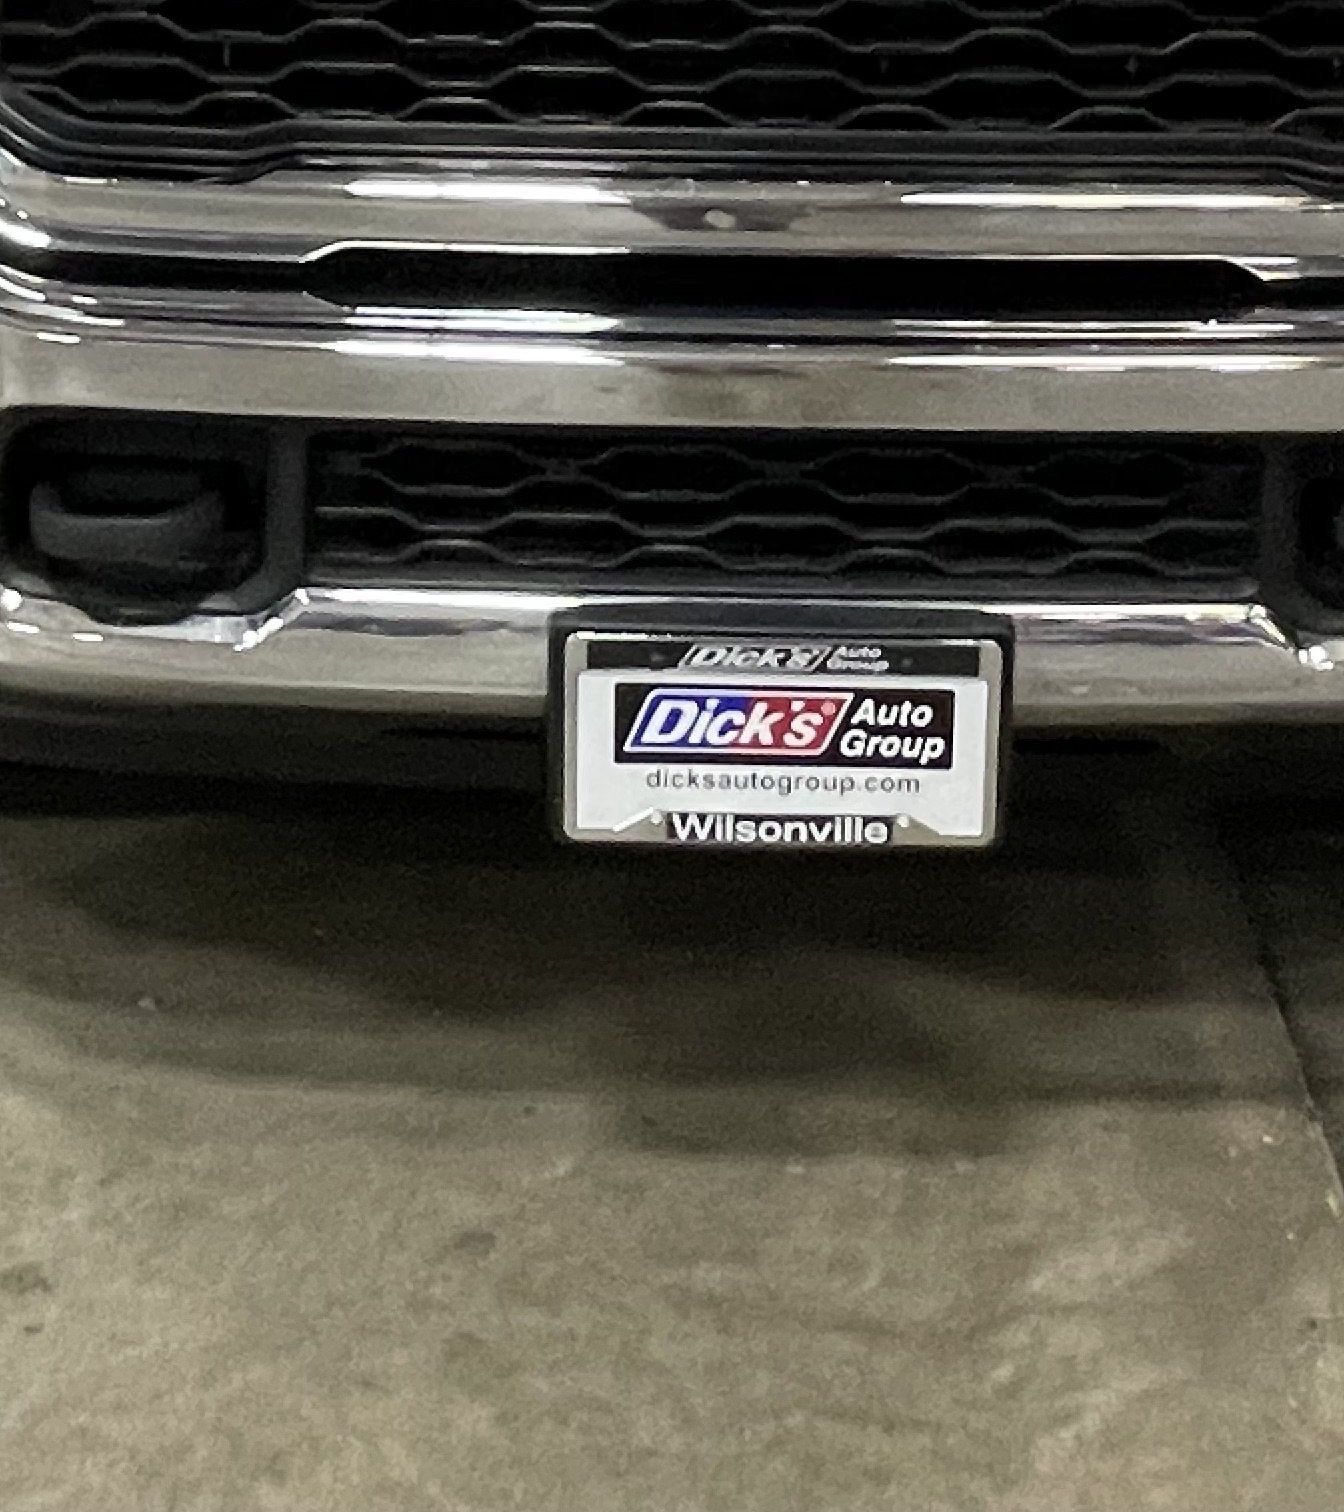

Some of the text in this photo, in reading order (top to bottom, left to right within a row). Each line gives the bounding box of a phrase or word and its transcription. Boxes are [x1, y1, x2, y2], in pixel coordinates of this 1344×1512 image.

[640, 698, 934, 747] Dick's Auto
[839, 728, 947, 765] Group
[645, 768, 921, 795] dicksautogroup.com
[671, 813, 890, 844] Wilsonville
